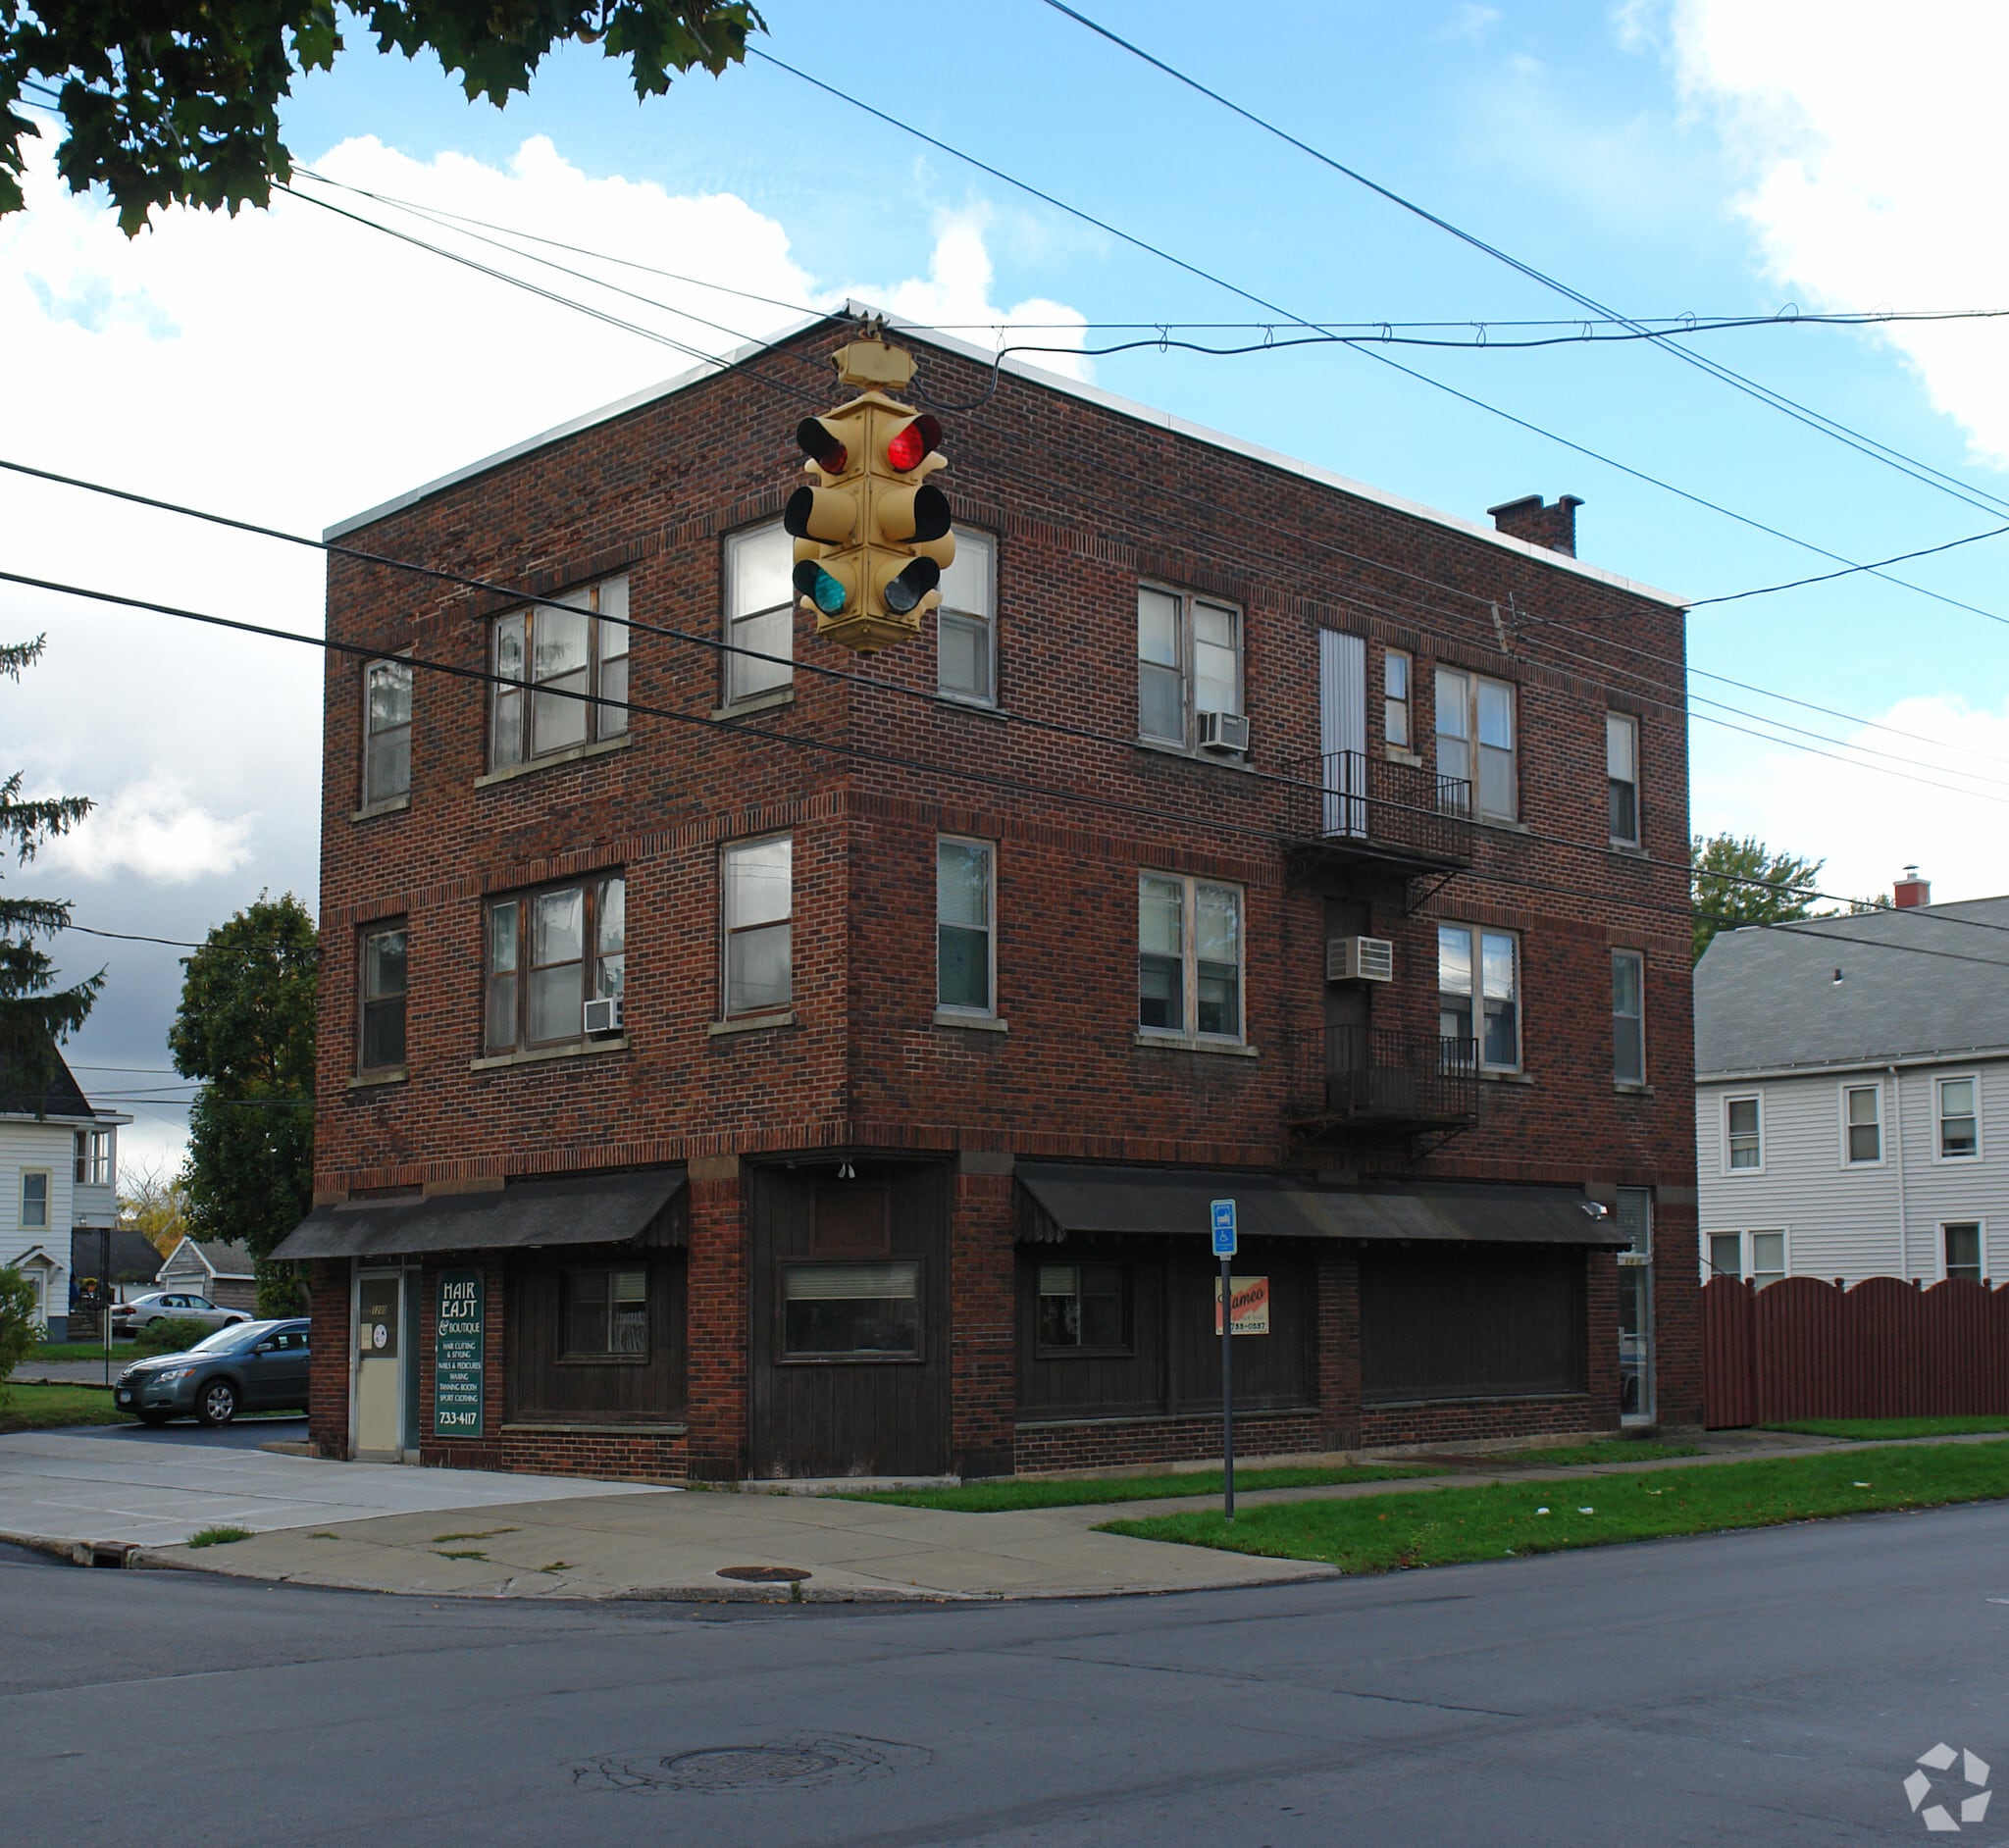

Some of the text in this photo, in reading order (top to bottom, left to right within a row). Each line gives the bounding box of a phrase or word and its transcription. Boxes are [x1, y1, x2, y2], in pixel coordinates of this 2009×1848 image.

[443, 1282, 476, 1300] HAIR
[441, 1300, 478, 1318] EAST
[438, 1319, 481, 1337] & BOUTIQUE
[442, 1342, 476, 1351] HAIR CUTTING
[460, 1383, 478, 1392] BOOTH
[454, 1394, 479, 1403] CLOTHING
[439, 1412, 478, 1425] 733-4117
